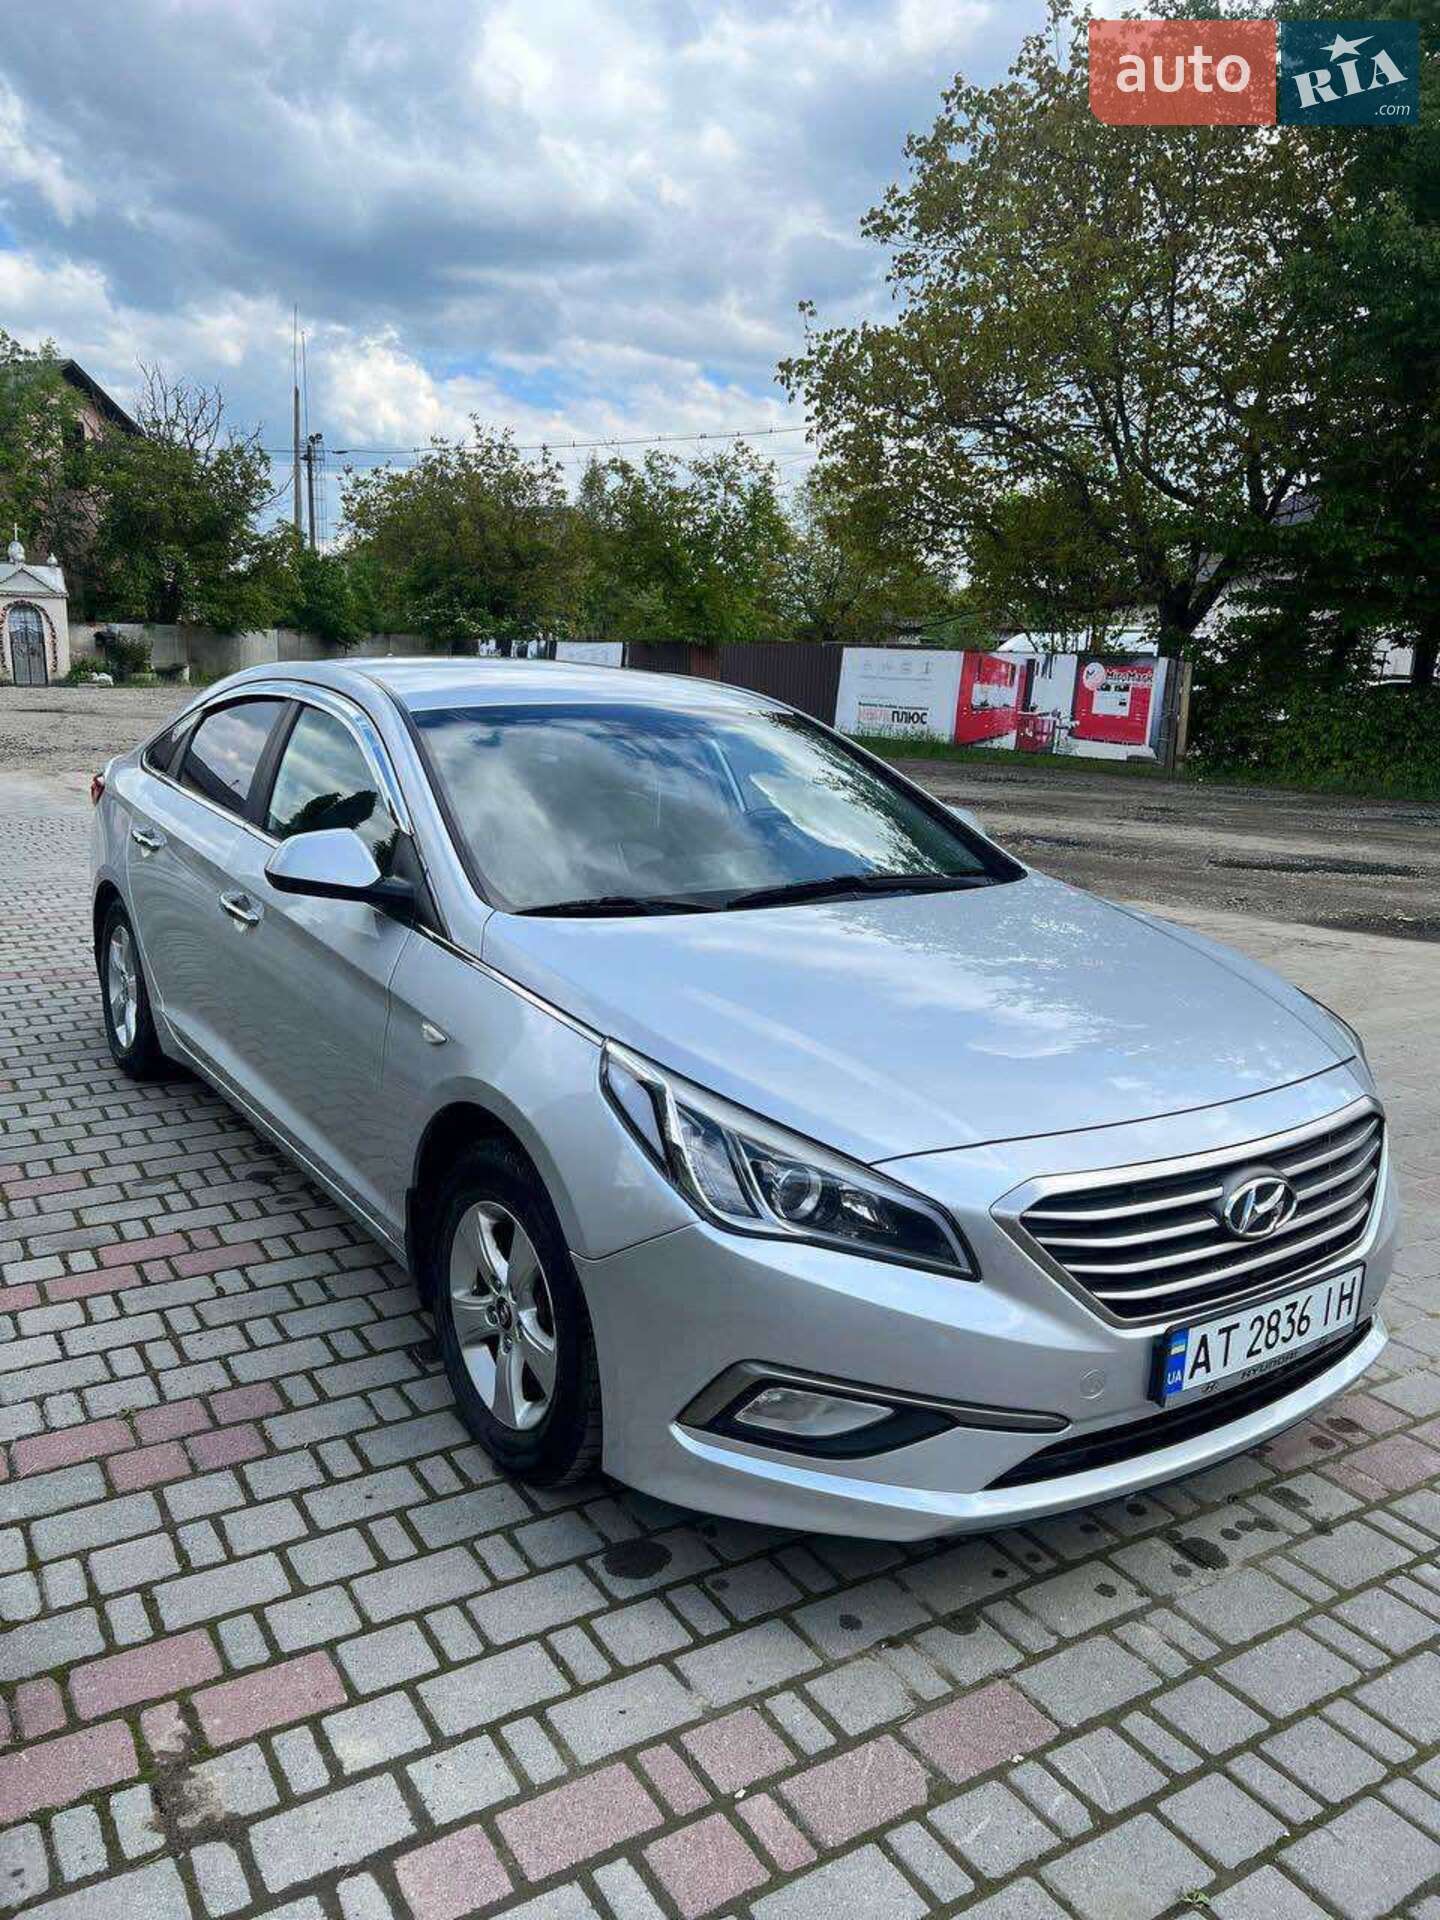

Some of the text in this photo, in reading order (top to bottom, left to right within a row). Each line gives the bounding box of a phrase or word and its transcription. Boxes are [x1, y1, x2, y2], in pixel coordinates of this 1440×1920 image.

[891, 710, 928, 725] ПЛЮС
[1188, 1276, 1357, 1380] AT 2836 IH
[1167, 1367, 1182, 1385] UA
